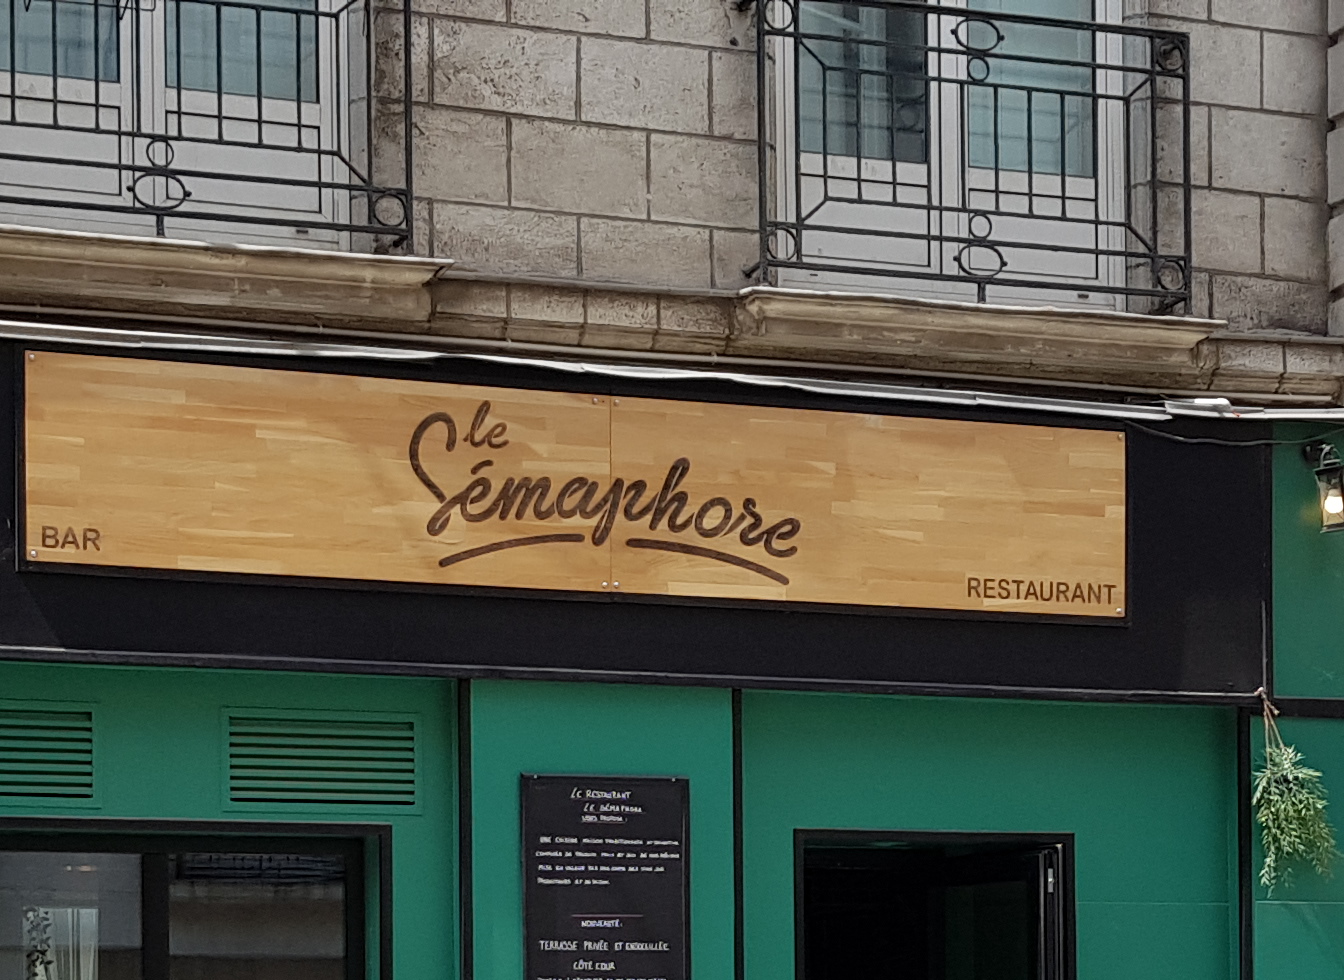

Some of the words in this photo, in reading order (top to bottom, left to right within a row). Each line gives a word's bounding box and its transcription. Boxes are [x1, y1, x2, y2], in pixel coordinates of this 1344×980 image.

[463, 400, 509, 449] le
[409, 411, 801, 557] Sémaphore
[41, 525, 101, 551] BAR
[967, 577, 1117, 605] RESTAURANT
[586, 789, 632, 799] RESTAURANT
[539, 939, 578, 950] TERRASSE
